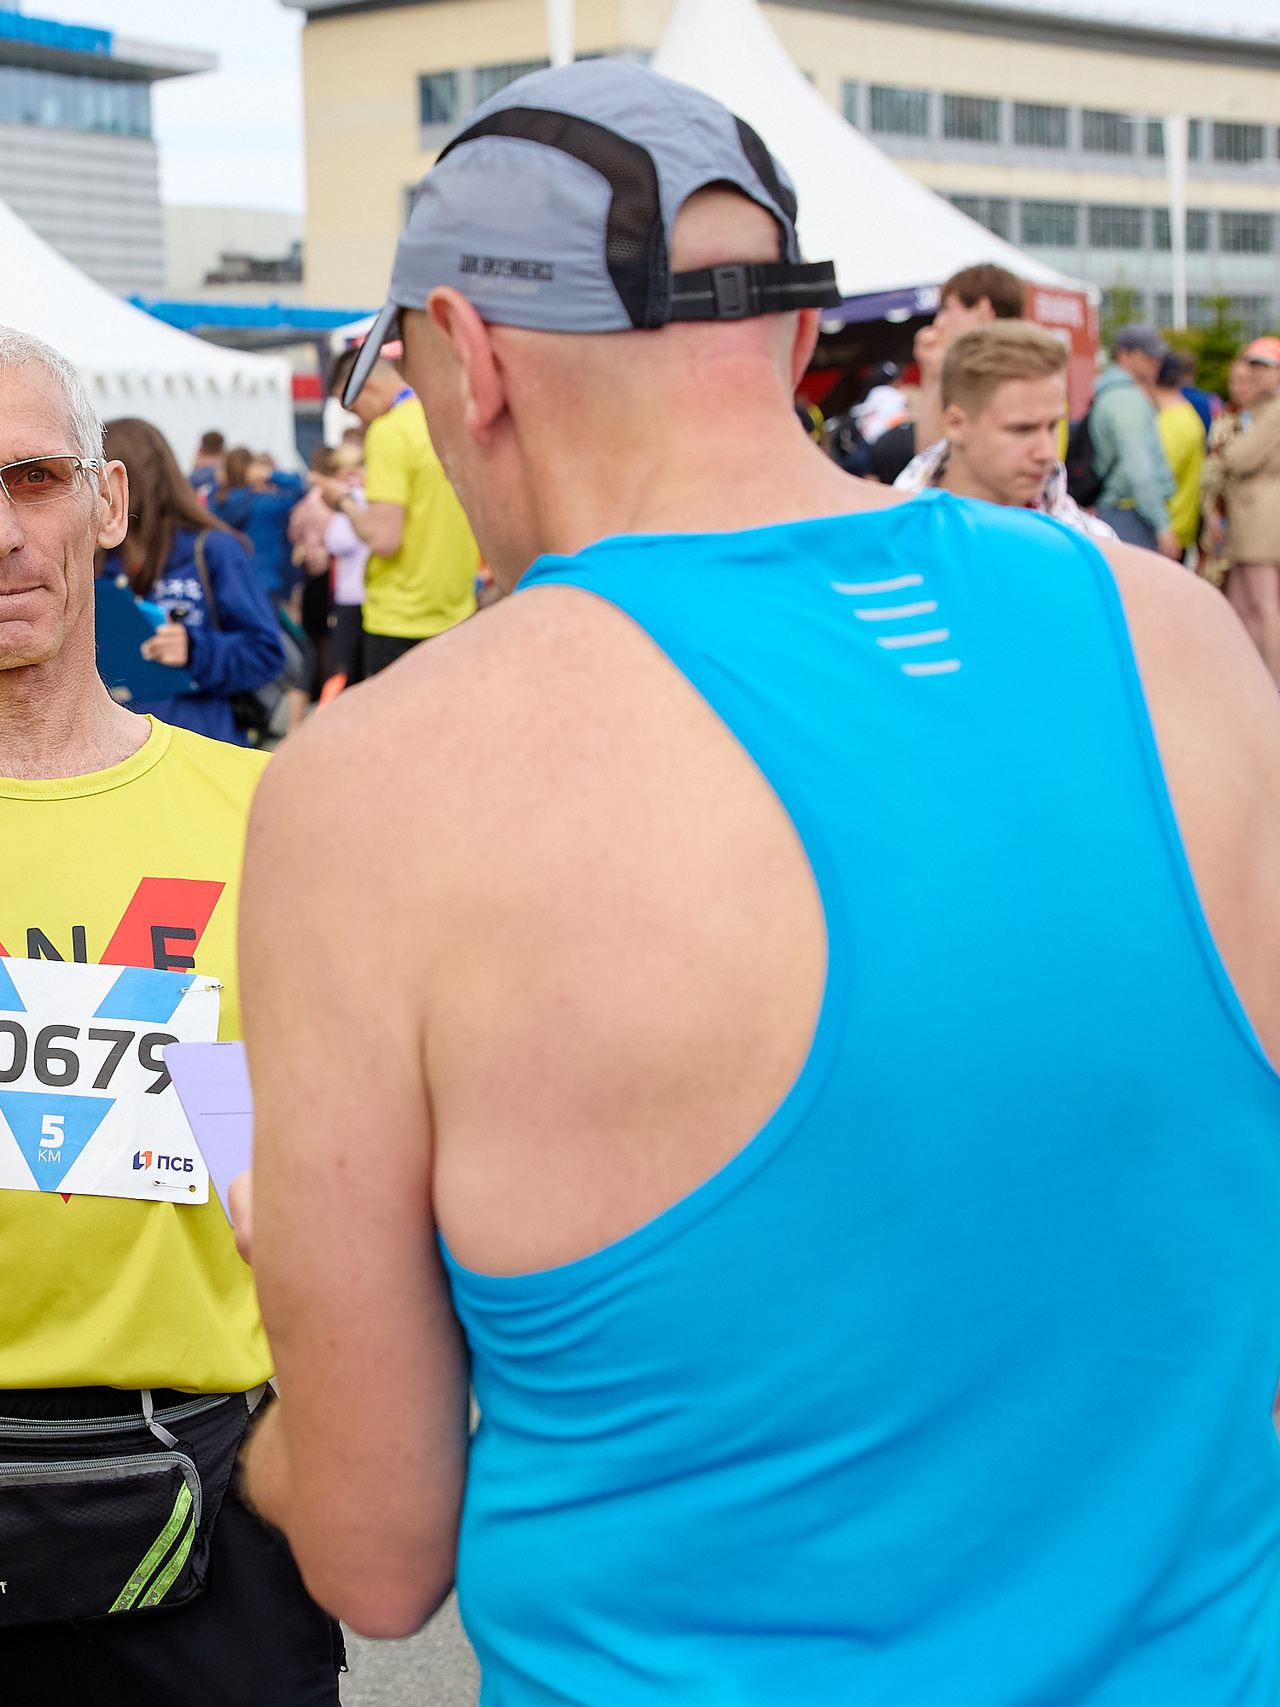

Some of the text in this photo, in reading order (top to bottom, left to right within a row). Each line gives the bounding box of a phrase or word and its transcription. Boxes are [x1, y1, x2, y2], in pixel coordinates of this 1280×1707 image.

[39, 1113, 65, 1149] 5
[37, 1149, 61, 1163] КМ
[157, 1155, 194, 1173] ПСБ
